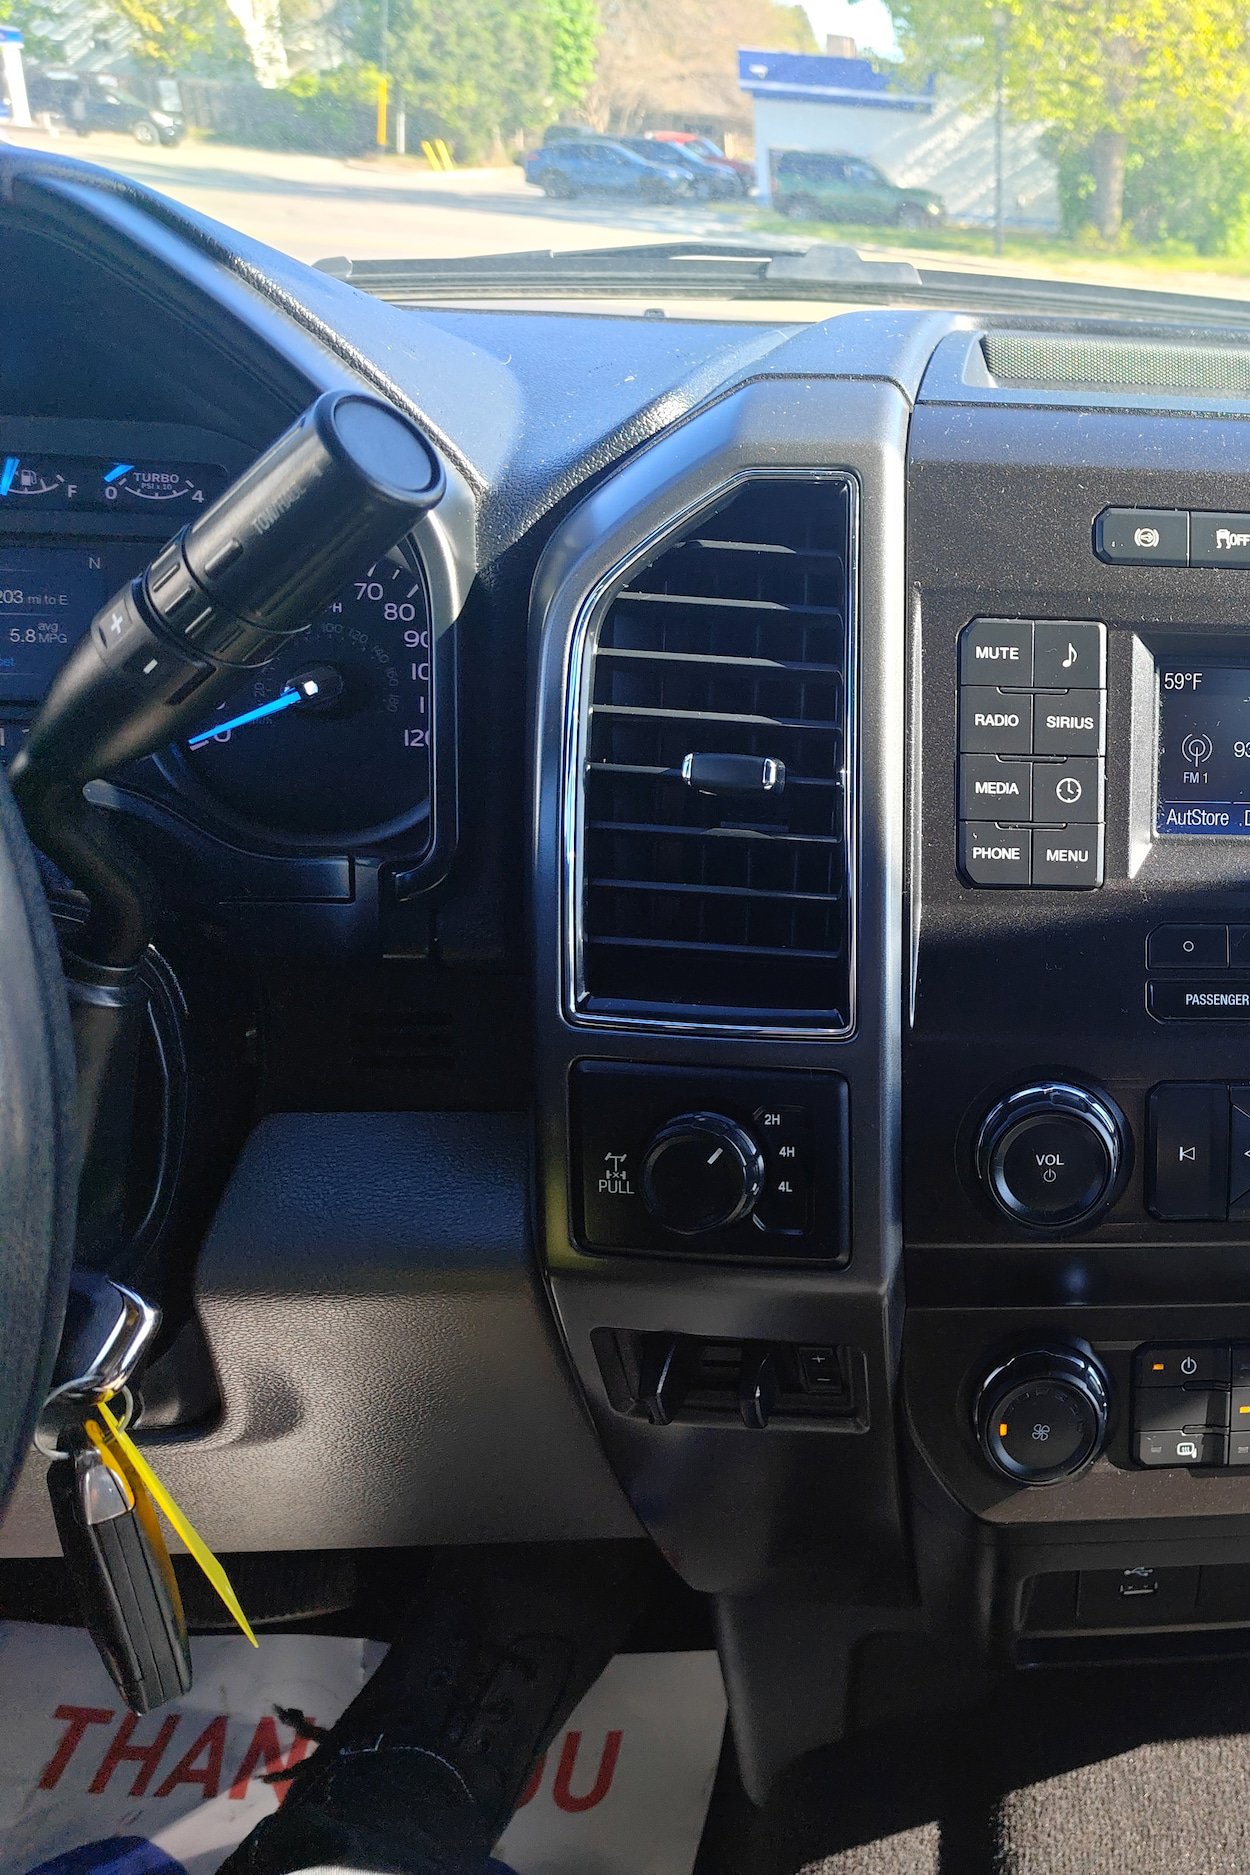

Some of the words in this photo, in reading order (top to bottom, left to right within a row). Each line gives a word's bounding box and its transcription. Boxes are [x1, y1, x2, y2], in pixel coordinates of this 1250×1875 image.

[134, 472, 179, 484] TURBO
[67, 484, 78, 498] F
[105, 486, 118, 499] 0
[141, 482, 154, 490] PSI
[191, 489, 205, 503] 4
[1229, 533, 1250, 547] OFF
[88, 557, 101, 569] N
[353, 582, 384, 601] 70
[27, 594, 42, 605] mi
[44, 594, 56, 605] to
[59, 594, 69, 606] E
[383, 603, 416, 621] 80
[38, 622, 59, 633] avg
[10, 628, 36, 643] 5.8
[38, 632, 68, 644] MPG
[975, 646, 1020, 661] MUTE
[1164, 672, 1203, 691] 59°F
[974, 713, 1020, 728] RADIO
[1046, 715, 1094, 730] SIRIUS
[1183, 771, 1200, 784] FM
[1202, 771, 1209, 784] 1
[975, 781, 1020, 795] MEDIA
[1166, 808, 1230, 827] AutStore
[972, 847, 1021, 860] PHONE
[1046, 848, 1089, 863] MENU
[1185, 993, 1250, 1006] PASSENGER
[764, 1113, 781, 1126] 2H
[779, 1145, 796, 1158] 4H
[1035, 1153, 1066, 1168] VOL
[598, 1179, 635, 1195] PULL
[778, 1181, 793, 1193] 4L
[38, 1704, 317, 1806] THAN
